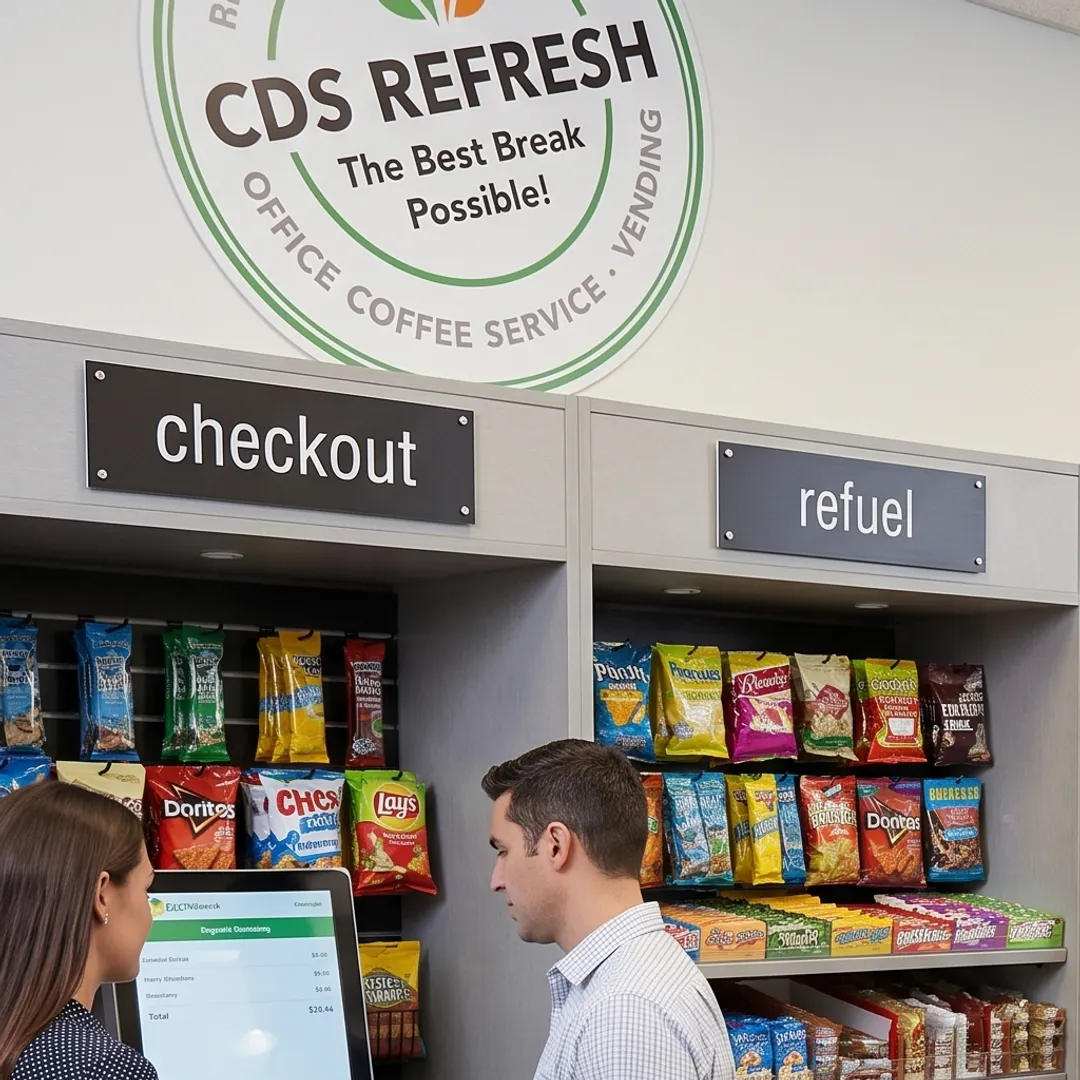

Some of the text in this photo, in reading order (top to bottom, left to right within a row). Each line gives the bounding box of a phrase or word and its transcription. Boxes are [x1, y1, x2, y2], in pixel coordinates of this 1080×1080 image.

[204, 20, 660, 149] CDS REFRESH
[337, 118, 587, 189] The Best Break
[243, 108, 662, 349] OFFICE COFFEE SERVICE VENDING
[406, 174, 552, 230] Possible!
[156, 402, 417, 488] checkout
[799, 480, 915, 539] refuel
[163, 799, 236, 819] Doritos
[377, 792, 418, 819] Lay's
[148, 1013, 169, 1021] Total
